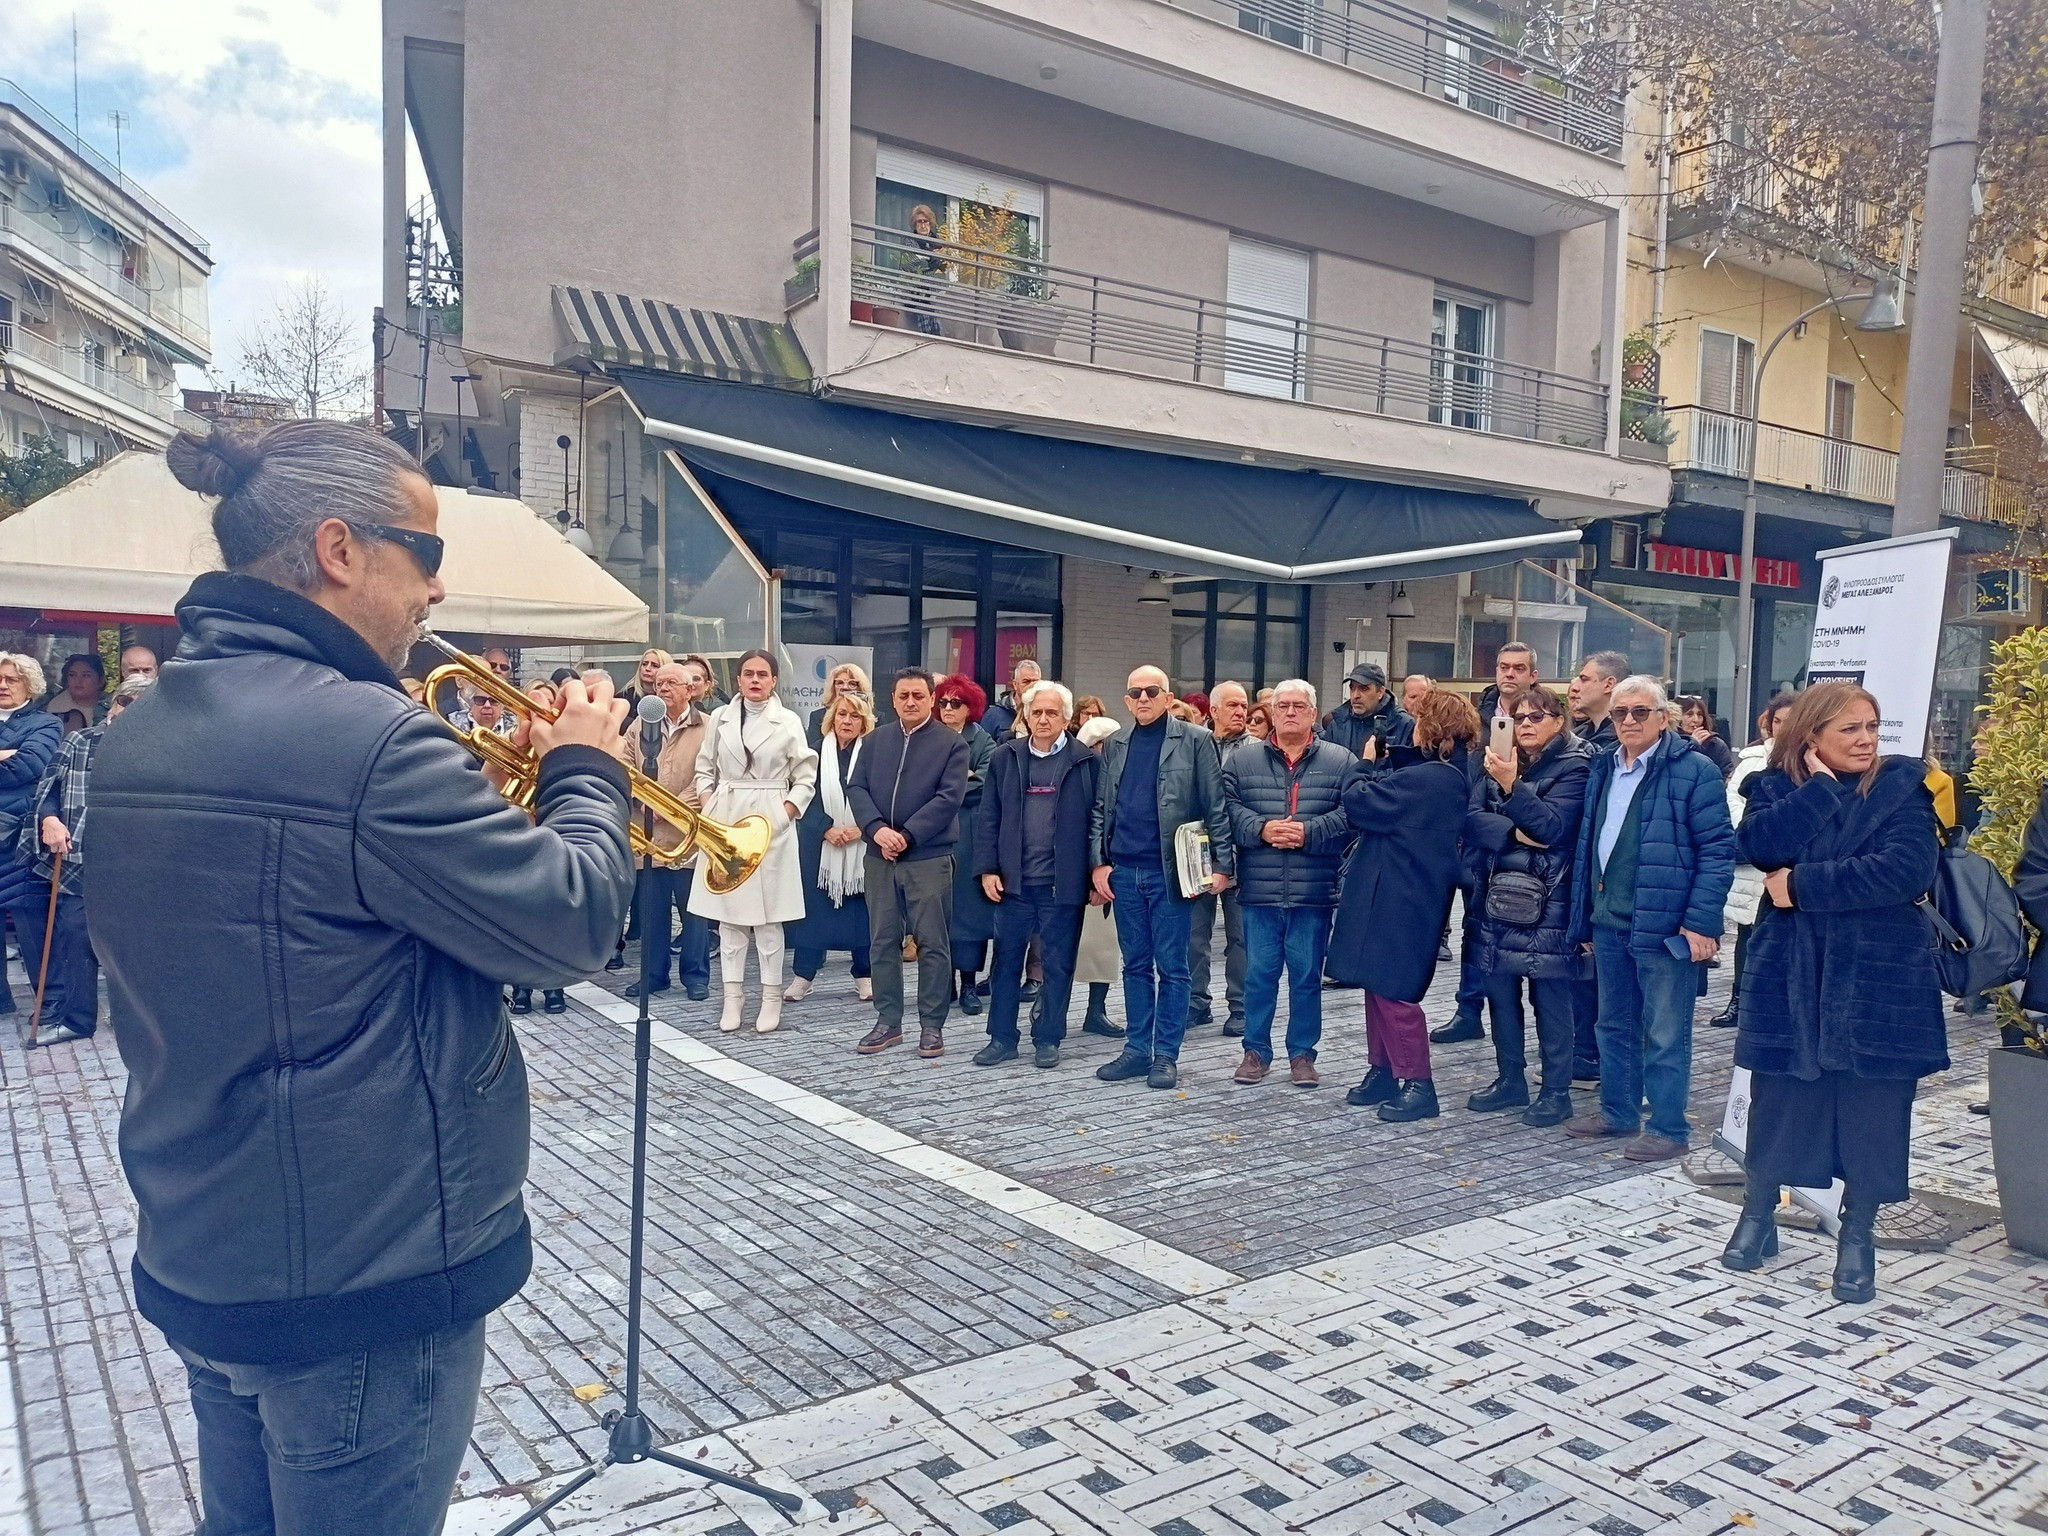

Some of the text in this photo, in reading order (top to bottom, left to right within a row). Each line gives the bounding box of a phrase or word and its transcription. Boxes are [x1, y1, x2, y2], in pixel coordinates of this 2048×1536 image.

[1651, 543, 1726, 578] TALLY
[1857, 586, 1894, 597] ΑΛΕΞΑΝΔΡΟΣ
[1815, 625, 1866, 637] ΣΤΗ ΜΝΗΜΗ
[1812, 639, 1840, 649] COVID-19
[782, 686, 825, 698] MACHA
